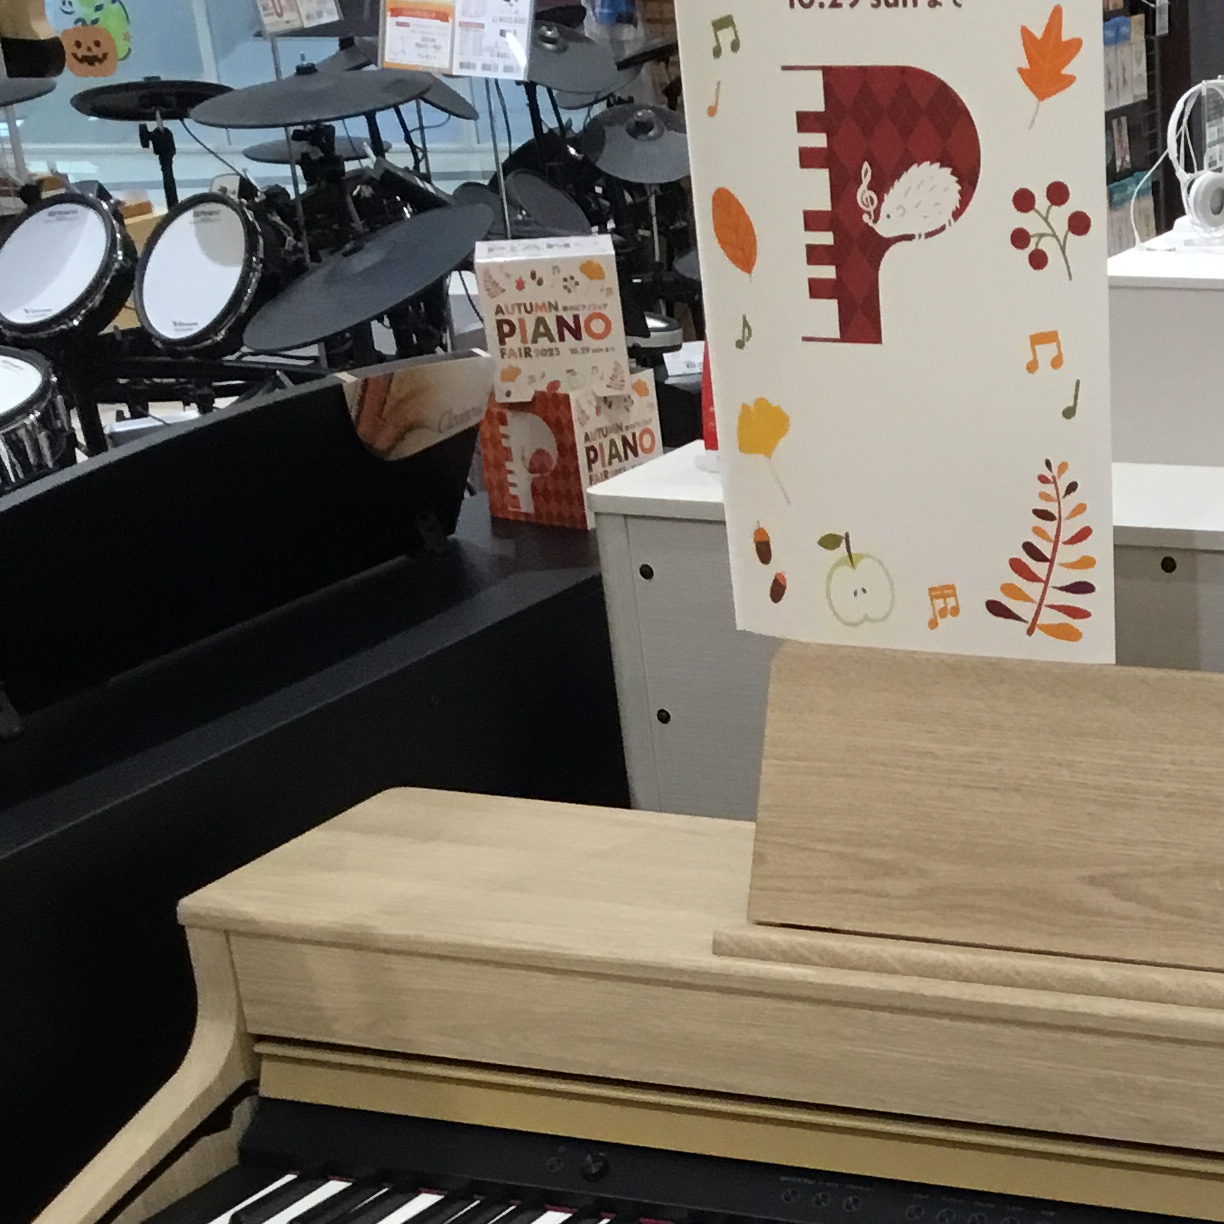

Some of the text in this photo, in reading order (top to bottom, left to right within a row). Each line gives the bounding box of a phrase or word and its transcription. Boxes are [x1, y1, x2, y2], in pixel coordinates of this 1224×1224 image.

[494, 300, 559, 316] AUTUMN
[495, 311, 613, 346] PIANO
[499, 346, 533, 359] FAIR
[534, 347, 561, 357] 2023
[584, 427, 656, 473] PIANO
